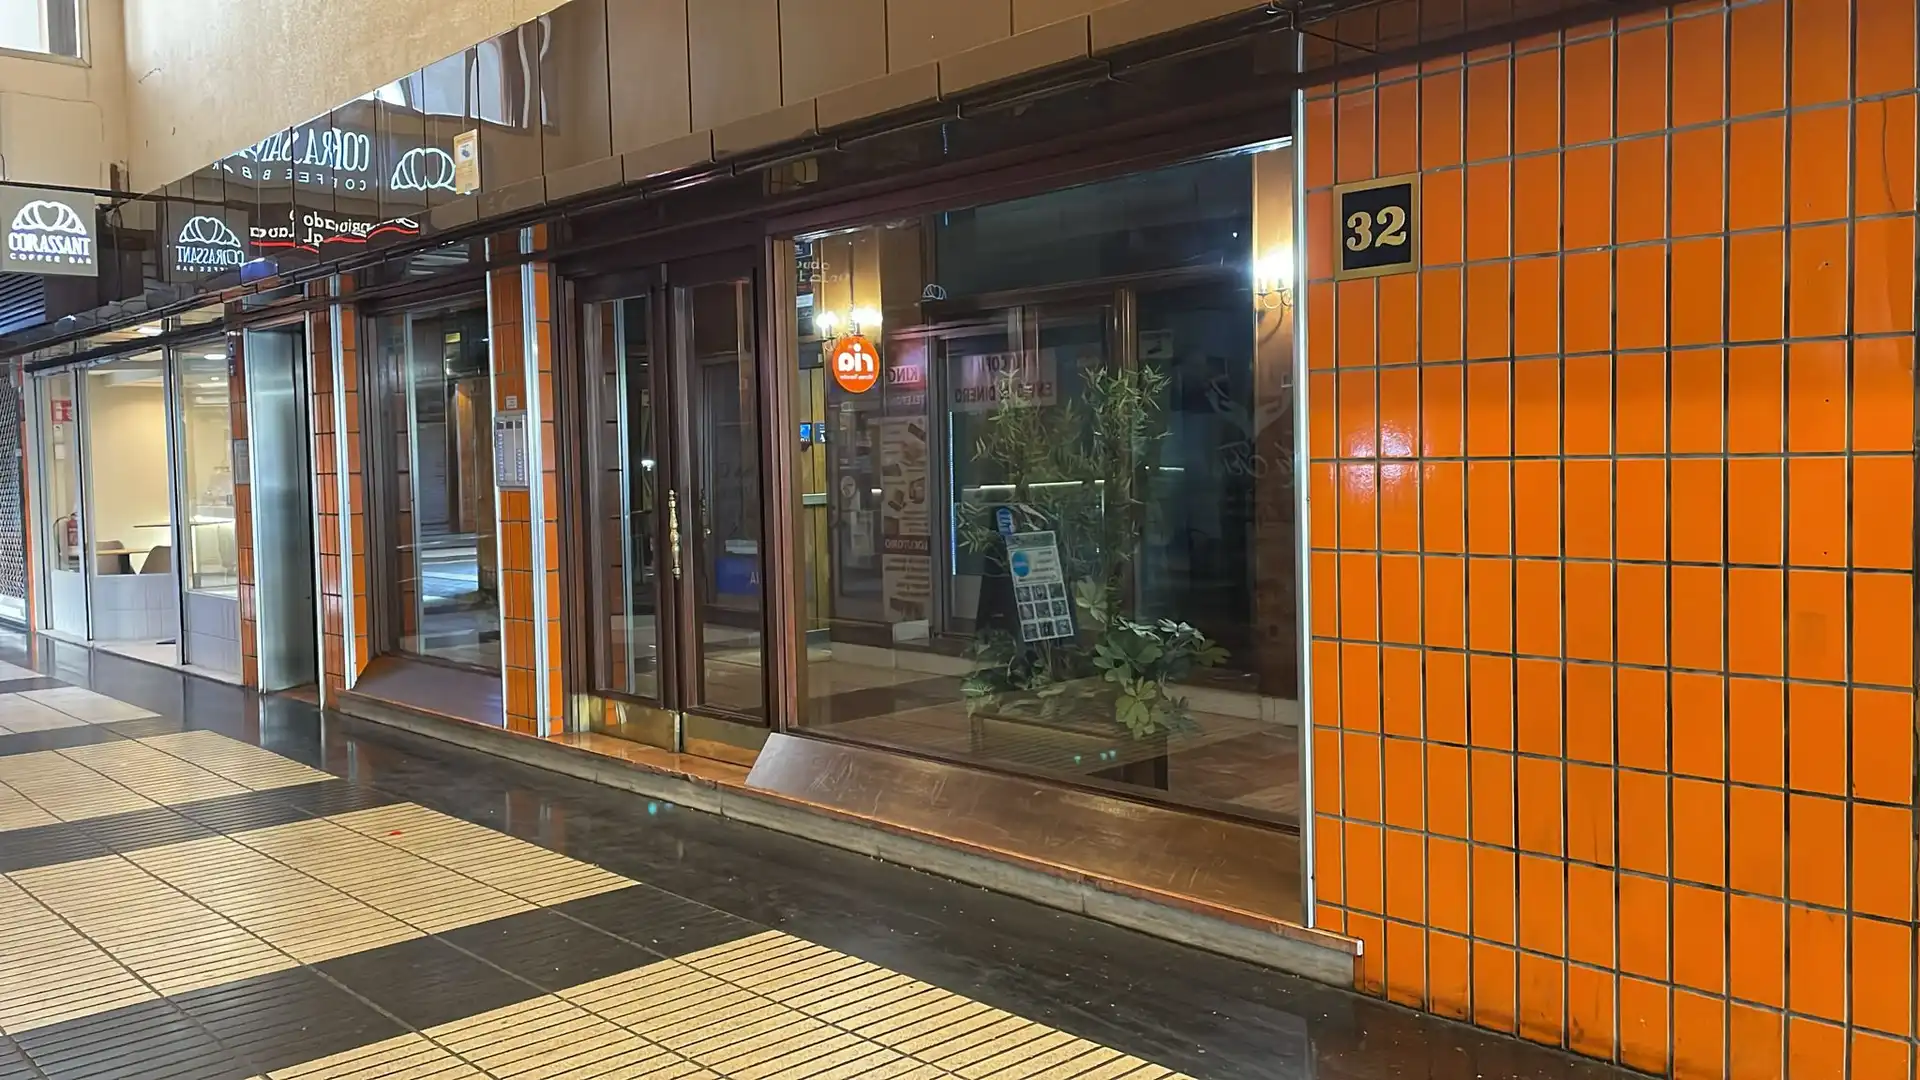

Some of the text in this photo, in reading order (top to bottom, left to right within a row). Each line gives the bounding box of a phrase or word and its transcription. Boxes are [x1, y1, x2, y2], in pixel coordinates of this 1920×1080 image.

[1346, 205, 1407, 252] 32
[8, 232, 91, 256] CORASSANT
[9, 252, 92, 265] COFFEE BAR
